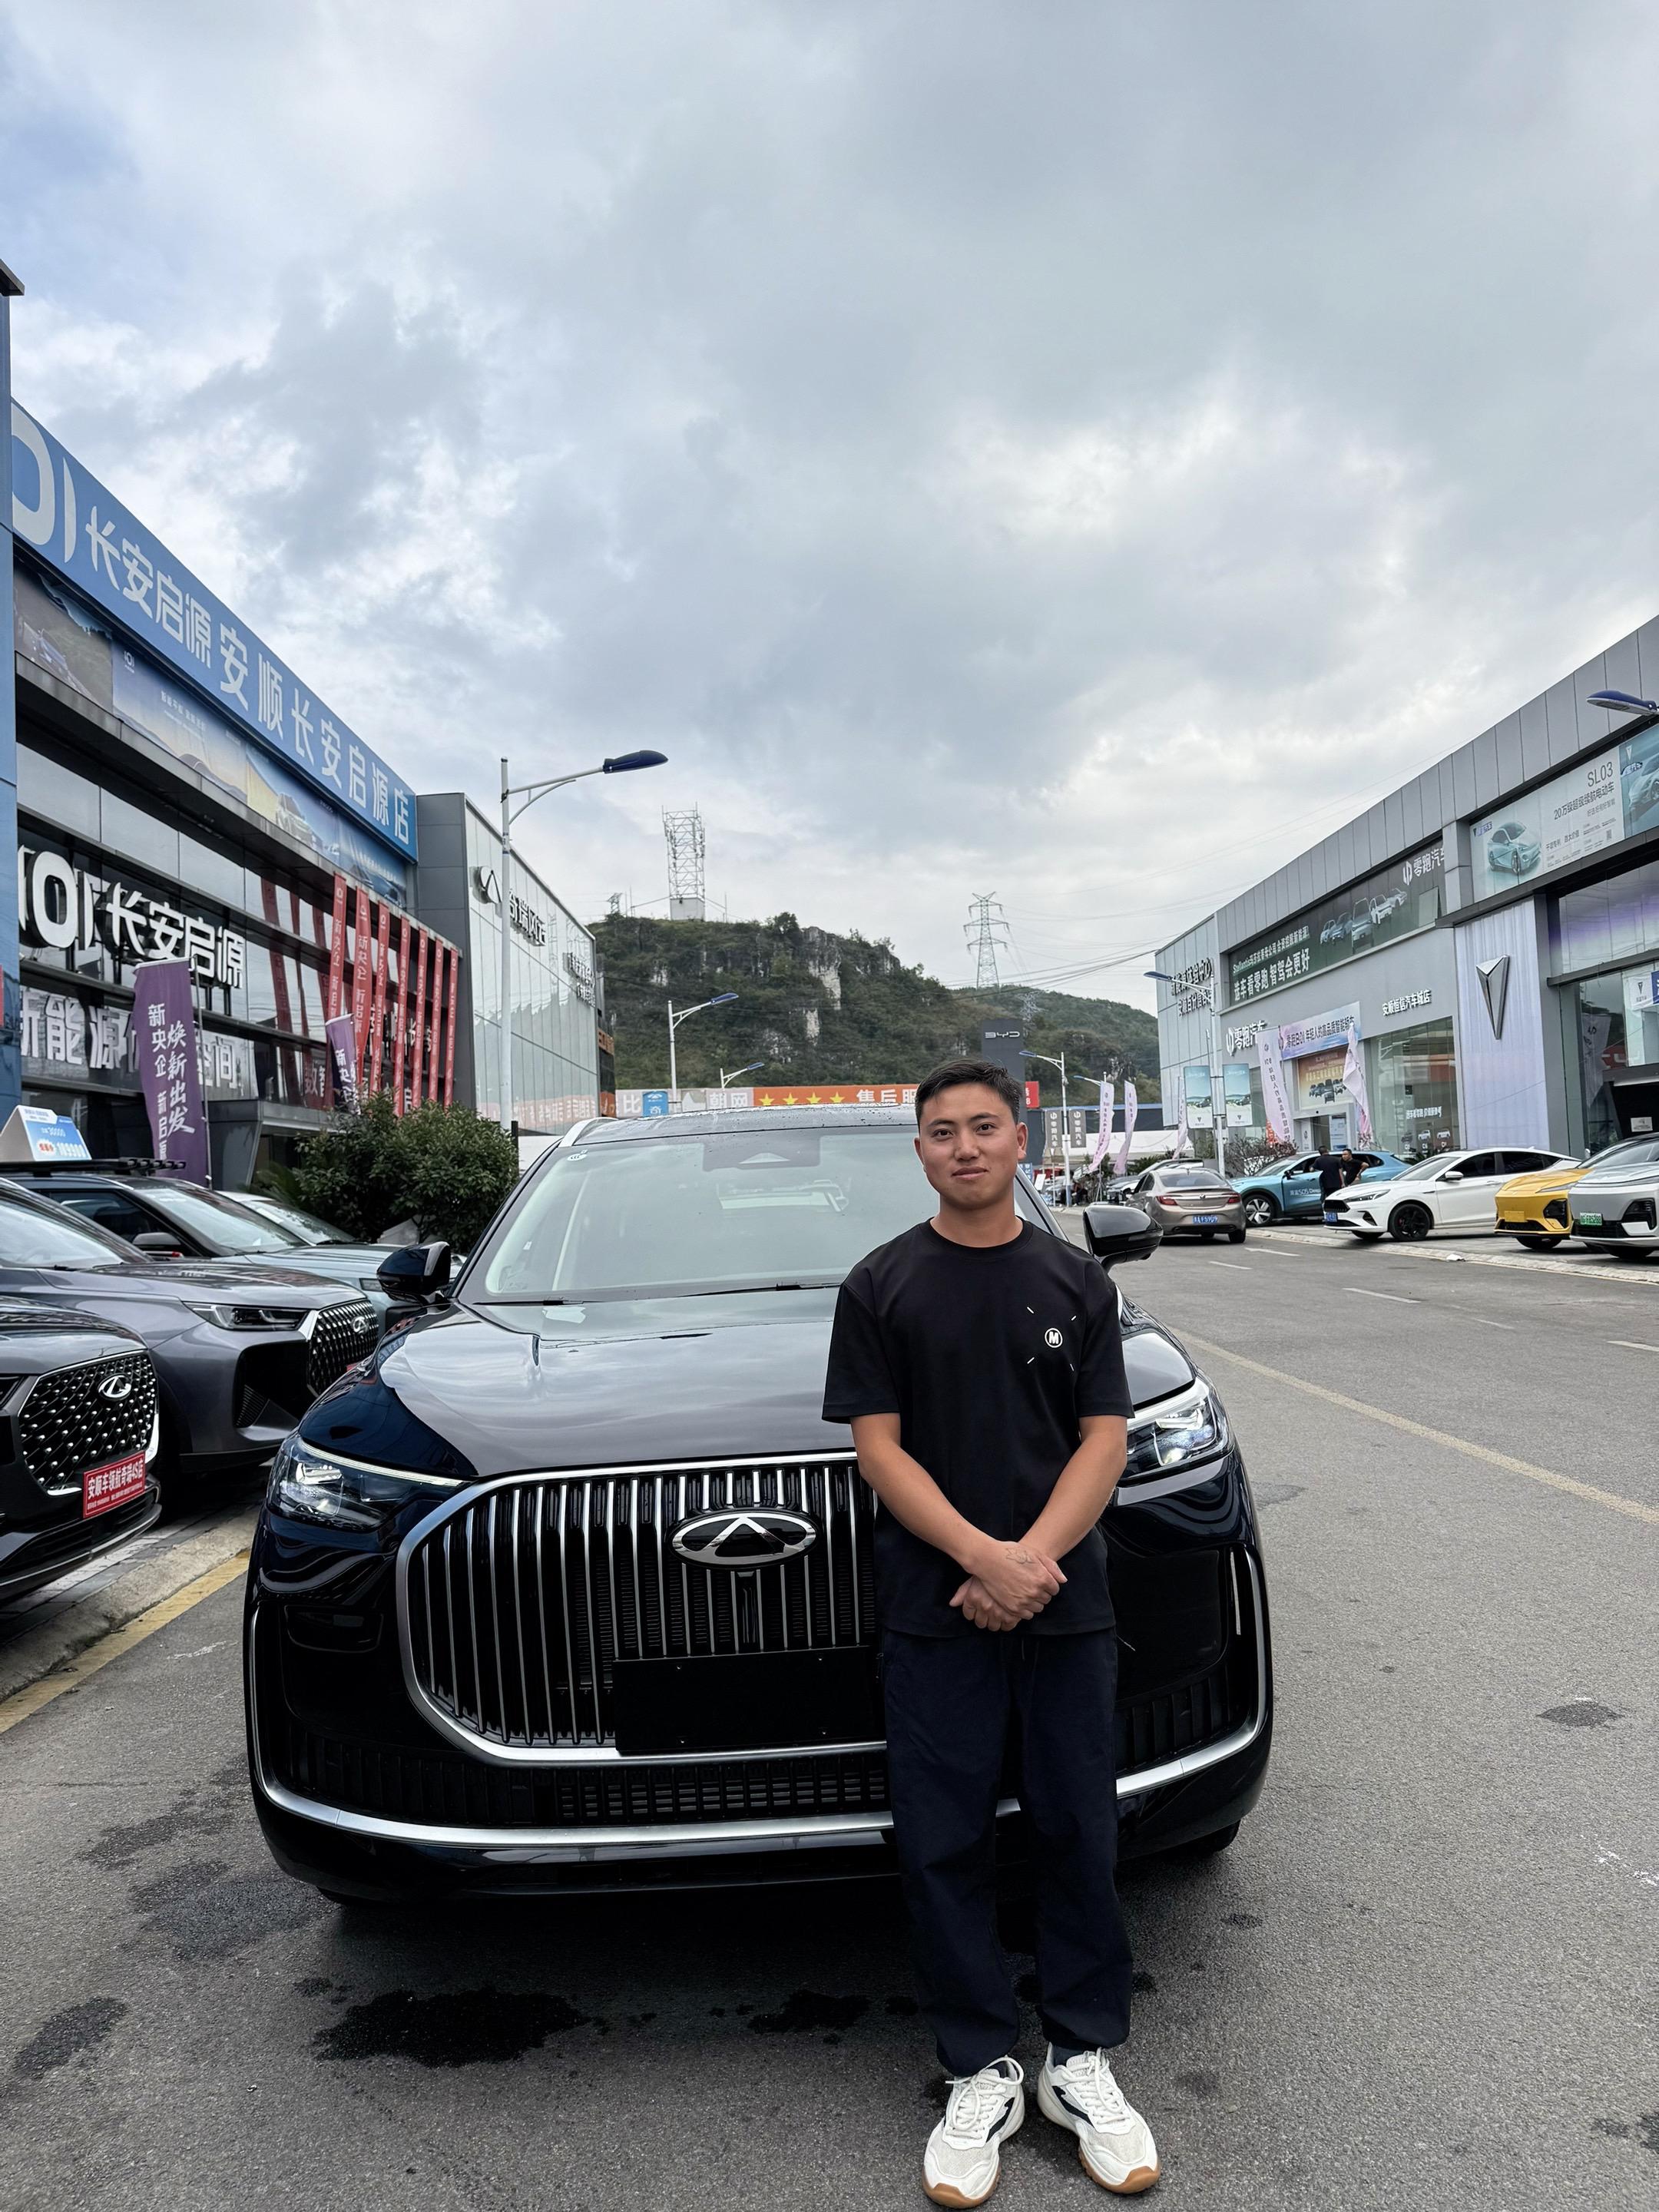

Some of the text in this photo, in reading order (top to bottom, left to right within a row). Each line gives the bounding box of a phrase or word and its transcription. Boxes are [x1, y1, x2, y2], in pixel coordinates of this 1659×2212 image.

[85, 505, 409, 845] 长安启源 安顺长安启源店
[1588, 762, 1613, 787] SL03
[105, 882, 245, 988] 长安启源
[147, 1003, 167, 1077] 新央企
